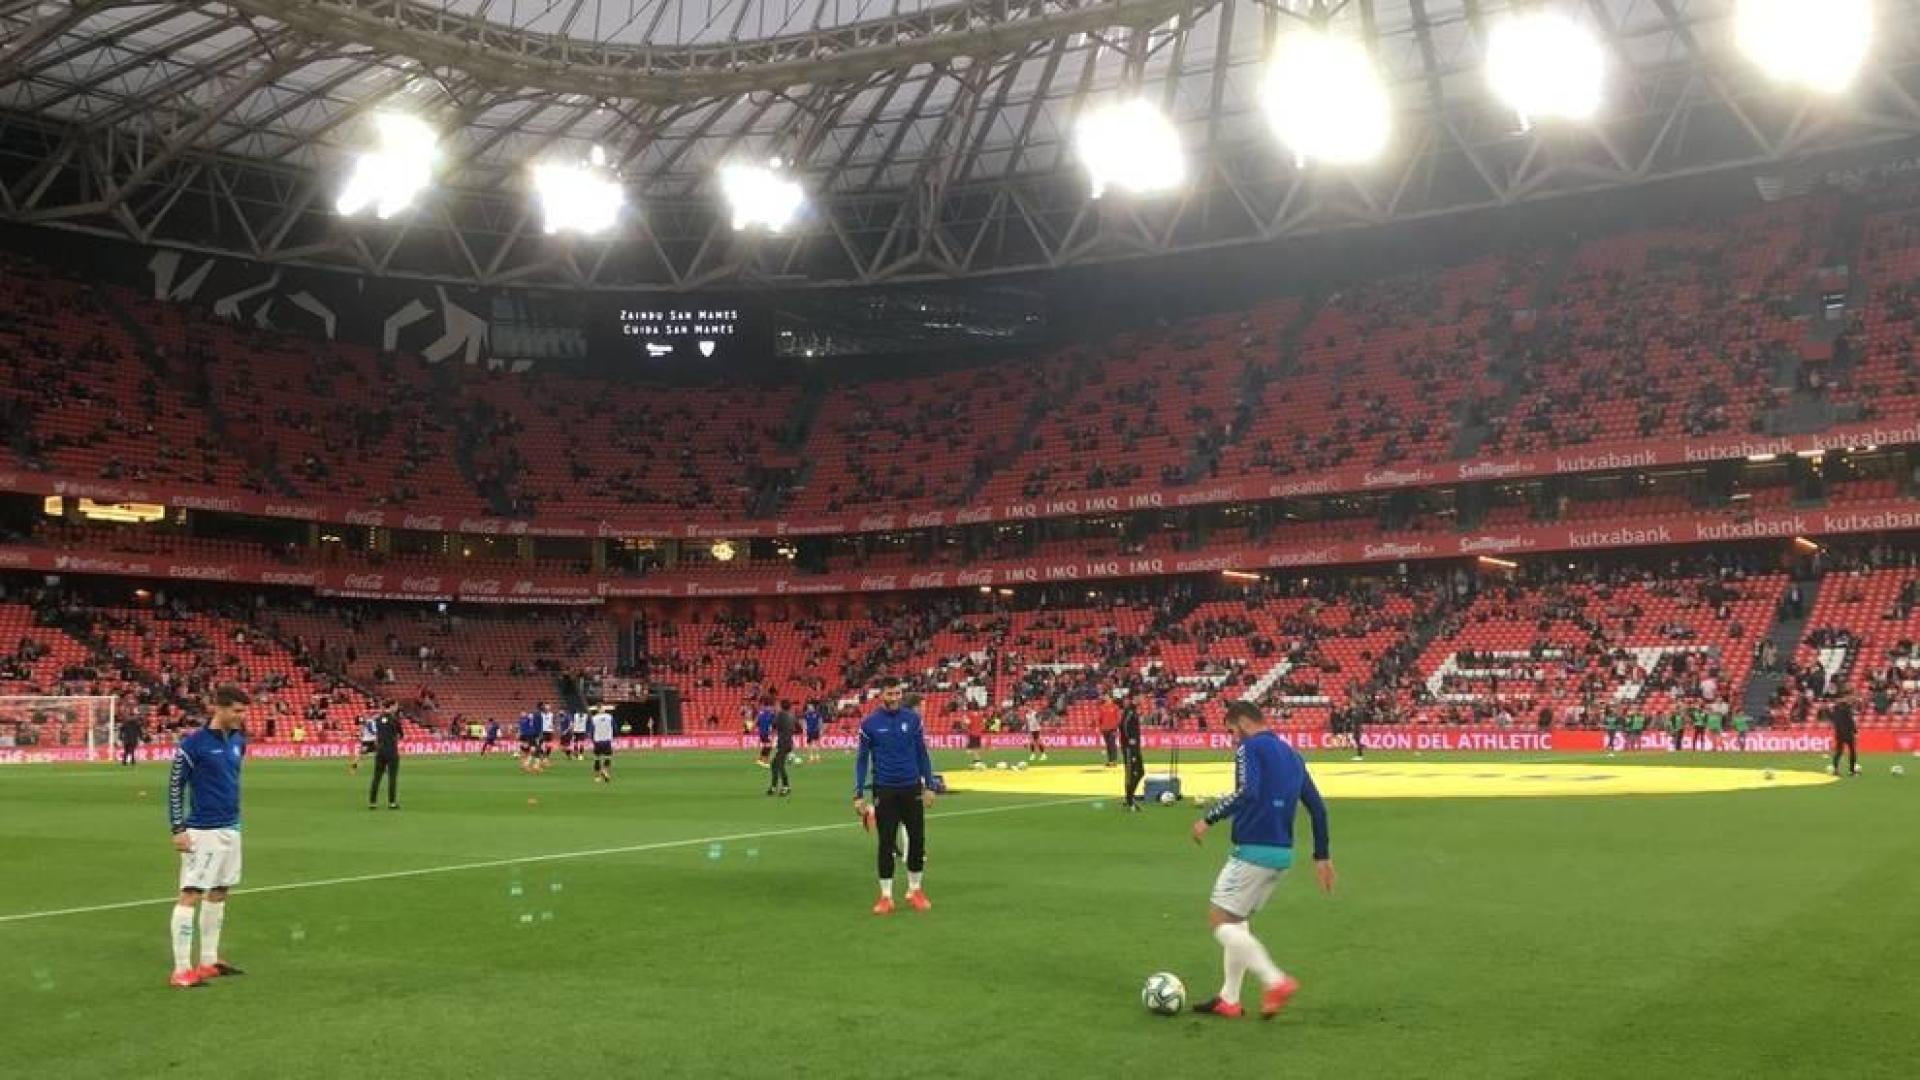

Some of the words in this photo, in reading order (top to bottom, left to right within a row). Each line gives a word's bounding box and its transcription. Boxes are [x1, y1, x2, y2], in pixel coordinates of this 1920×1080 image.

[670, 309, 692, 321] SAN
[665, 324, 688, 335] SAN
[1556, 450, 1657, 473] kutxabank
[1685, 438, 1796, 462] kutxabank
[1005, 503, 1037, 517] IMQ
[1046, 500, 1078, 514] IMQ
[1086, 496, 1119, 511] IMQ
[1129, 492, 1163, 508] IMQ
[1696, 516, 1807, 540] kutxabank
[1823, 511, 1920, 534] kutxaba
[1568, 525, 1672, 548] kutxabank
[1005, 567, 1038, 581] IMQ
[1046, 564, 1079, 579] IMQ
[1087, 561, 1120, 576] IMQ
[1129, 558, 1164, 573] IMQ
[1298, 733, 1318, 748] EL
[1417, 732, 1454, 750] DEL
[1457, 732, 1553, 750] ATHLETIC
